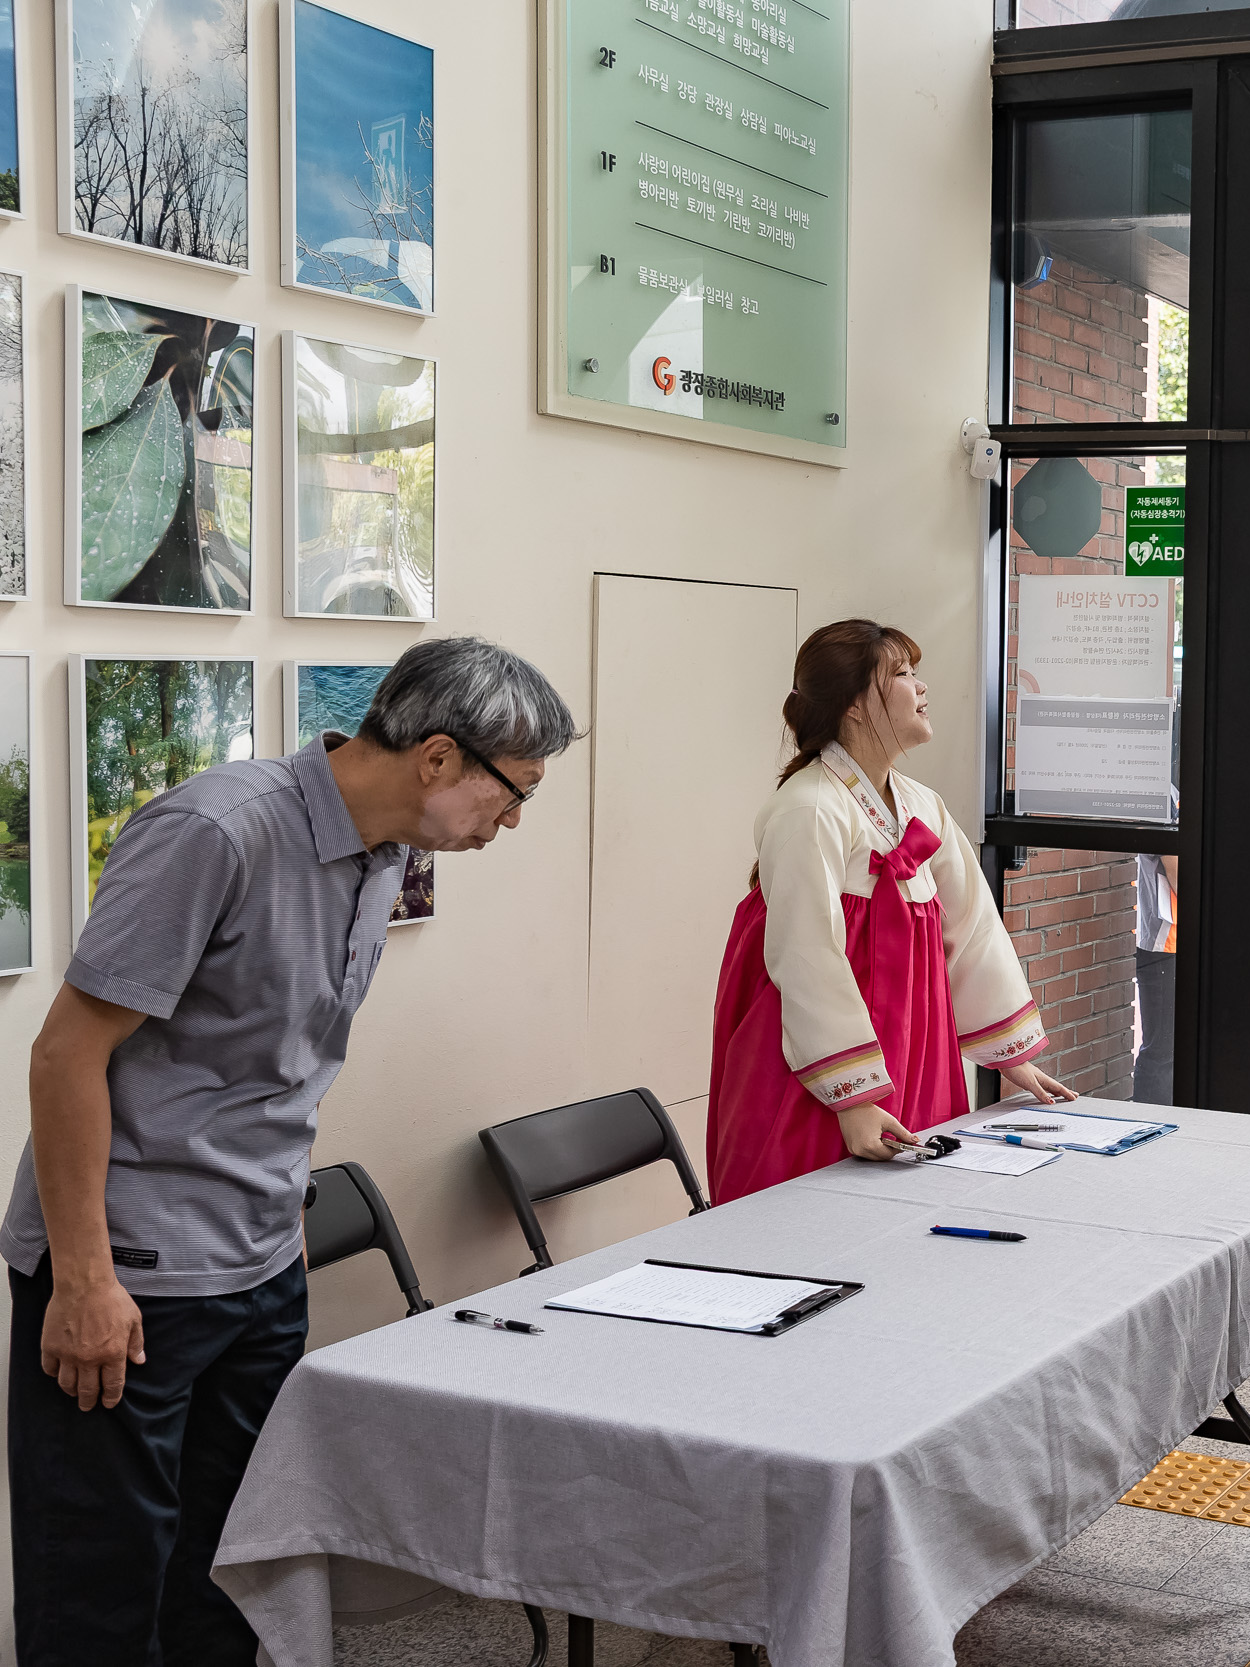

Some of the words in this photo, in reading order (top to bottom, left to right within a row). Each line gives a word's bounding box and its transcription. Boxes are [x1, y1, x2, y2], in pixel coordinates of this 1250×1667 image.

[645, 0, 679, 22] 교실
[686, 12, 726, 44] 소망교실
[733, 32, 769, 65] 희망교실
[751, 17, 795, 54] 미술활동실
[599, 46, 617, 69] 2F
[638, 63, 669, 93] 사무실
[677, 80, 698, 104] 강당
[704, 92, 733, 120] 관장실
[740, 107, 767, 135] 상담실
[774, 122, 816, 155] 피아노교실
[600, 150, 617, 173] 1F
[638, 152, 669, 179] 사랑의
[671, 163, 710, 194] 어린이집
[712, 178, 744, 207] (원무실
[751, 194, 778, 219] 조리실
[784, 206, 810, 230] 나비반
[638, 179, 679, 210] 병아리반
[686, 196, 716, 222] 토끼반
[723, 209, 751, 234] 기린반
[757, 221, 796, 250] 코끼리반)
[600, 254, 616, 276] B1
[637, 265, 690, 297] 물품보관실
[696, 284, 734, 311] 보일러실
[740, 295, 760, 315] 창고
[679, 369, 786, 412] 광장종합사회복지관
[1136, 496, 1180, 507] 자동제세동기
[1151, 546, 1185, 561] AED
